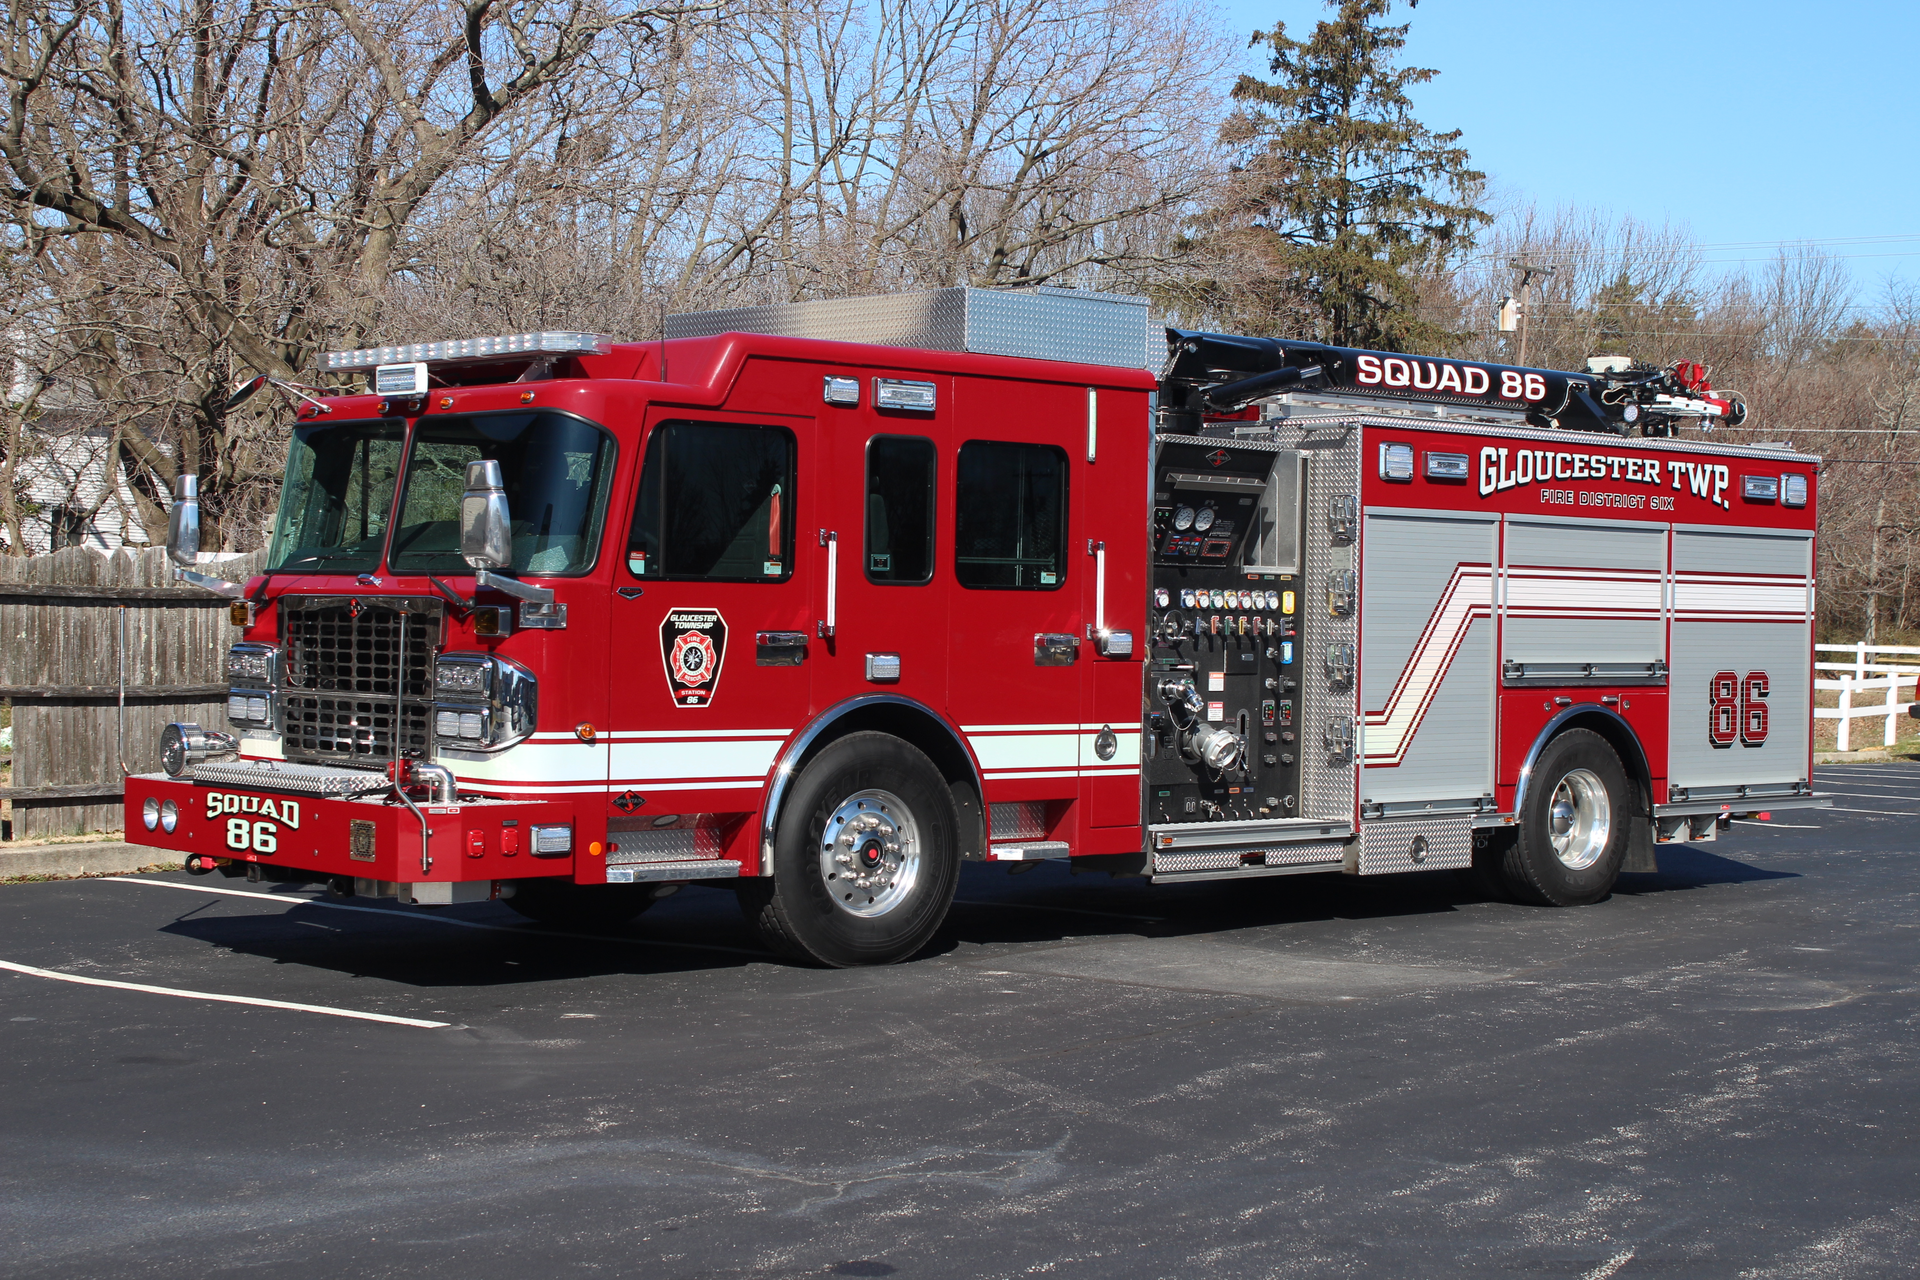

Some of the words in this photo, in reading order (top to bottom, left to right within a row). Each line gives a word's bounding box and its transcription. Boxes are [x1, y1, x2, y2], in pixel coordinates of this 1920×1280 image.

[1356, 355, 1490, 395] SQUAD
[1500, 370, 1546, 401] 86
[1479, 446, 1661, 496] GLOUCESTER
[1667, 460, 1729, 510] TWP.
[1540, 488, 1574, 504] FIRE
[1579, 491, 1646, 509] DISTRICT
[1650, 496, 1675, 511] SIX
[670, 614, 717, 622] GLOUCESTER
[674, 621, 714, 629] TOWNSHIP
[687, 635, 701, 643] FIRE
[684, 674, 702, 682] RESCUE
[686, 696, 699, 704] 86
[1709, 670, 1770, 749] 86
[206, 792, 300, 829] SQUAD
[226, 818, 277, 853] 86
